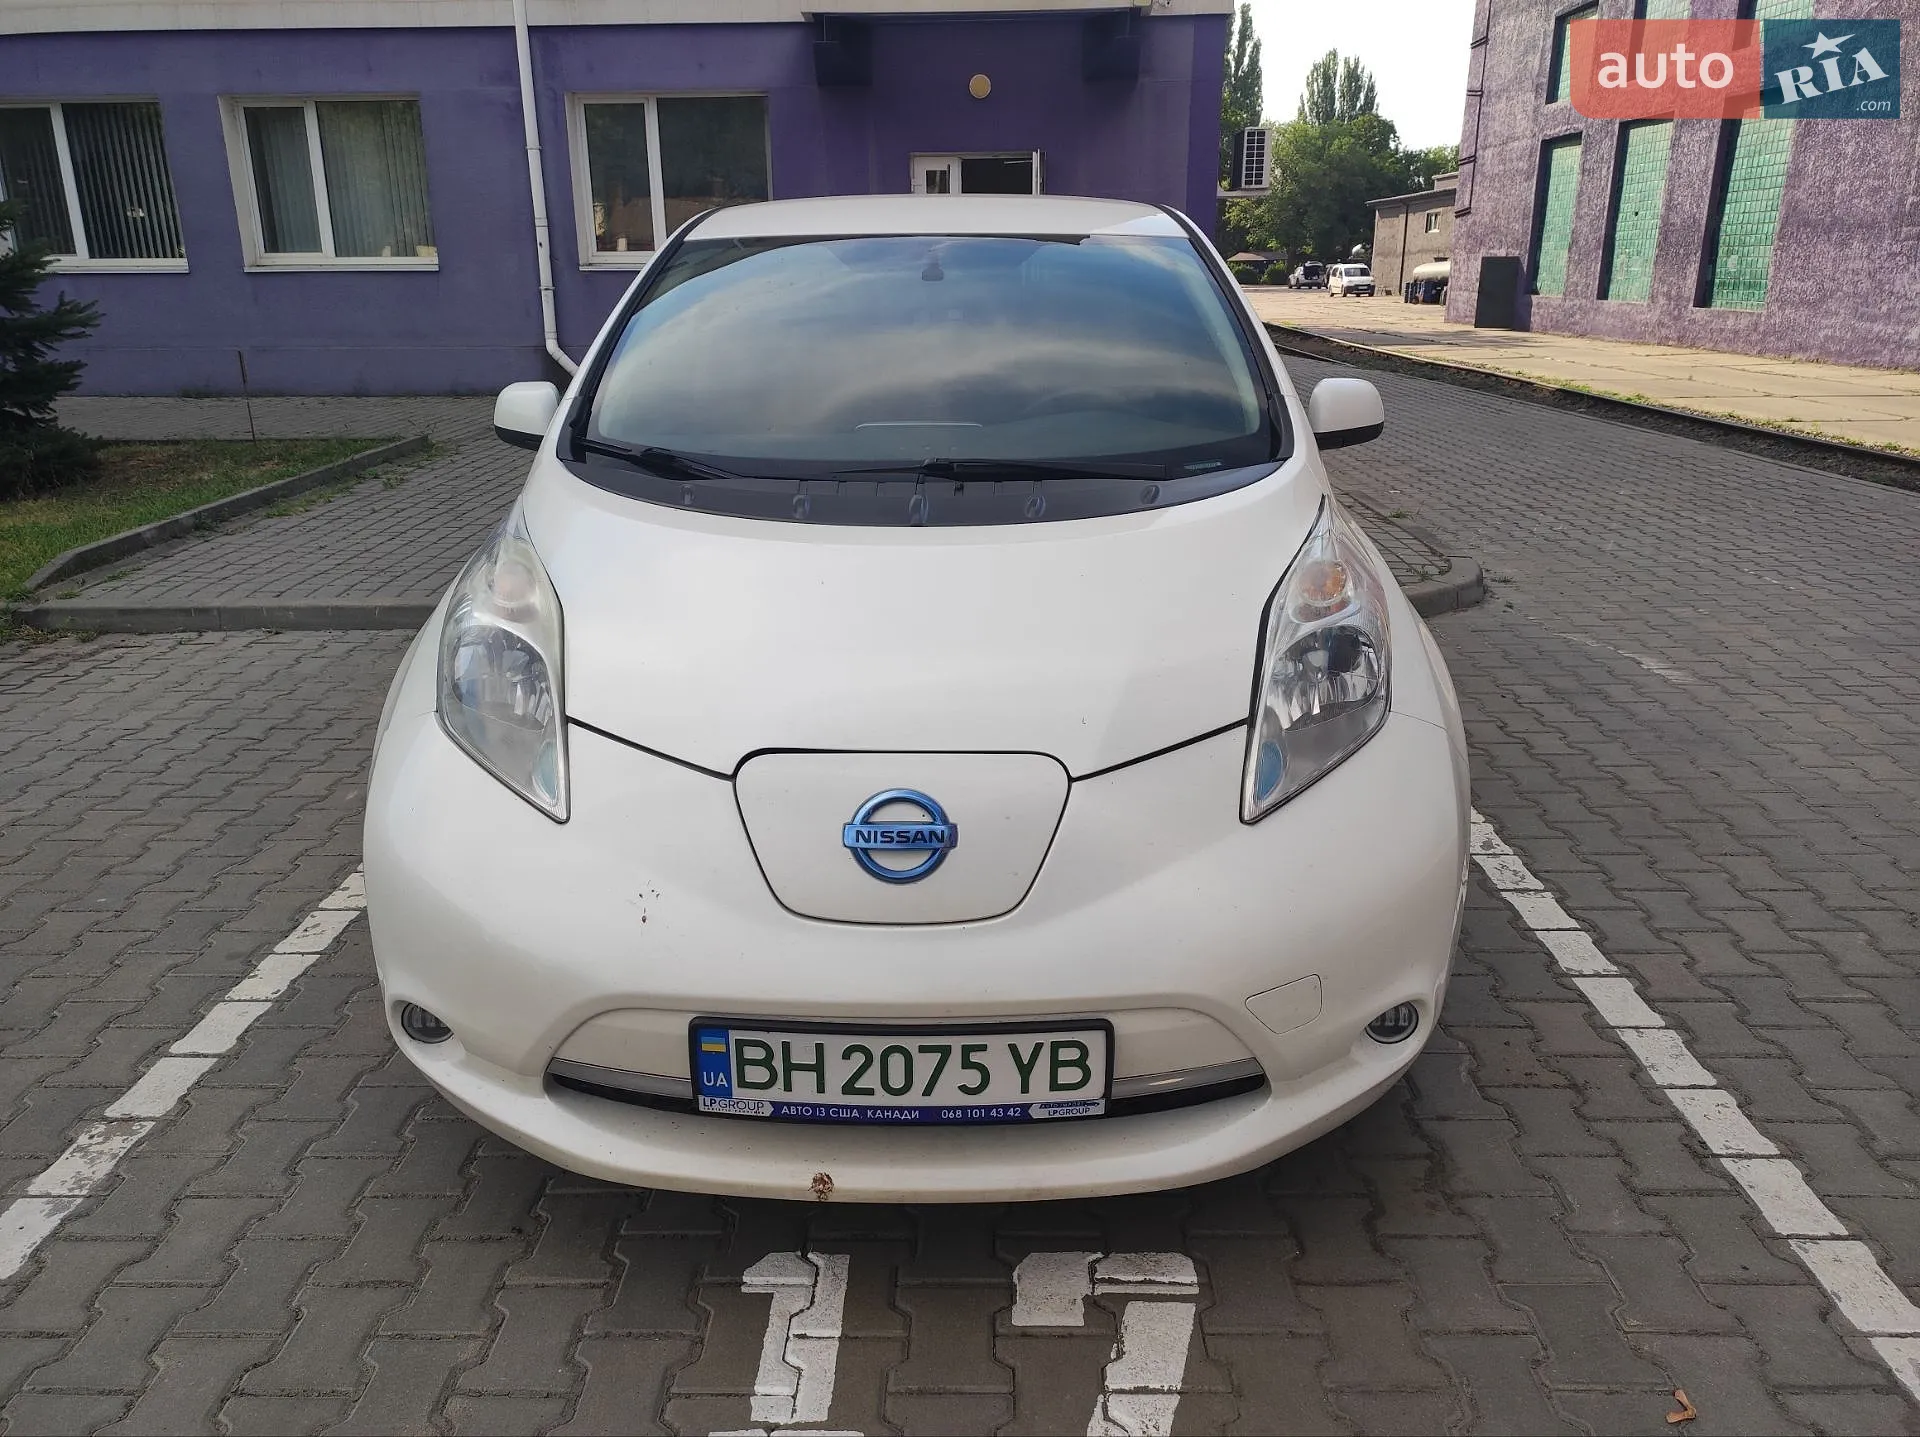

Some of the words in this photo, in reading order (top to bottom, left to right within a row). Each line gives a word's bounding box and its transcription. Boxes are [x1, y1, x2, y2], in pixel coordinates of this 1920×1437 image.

[855, 829, 945, 844] NISSAN
[734, 1038, 825, 1094] BH
[841, 1044, 990, 1097] 2075
[1007, 1039, 1092, 1095] YB
[703, 1072, 728, 1088] UA
[781, 1106, 813, 1116] АВТО
[867, 1109, 919, 1119] КАНАДИ
[941, 1109, 962, 1119] 068
[967, 1109, 985, 1118] 101
[990, 1108, 1004, 1117] 43
[1006, 1107, 1021, 1117] 42
